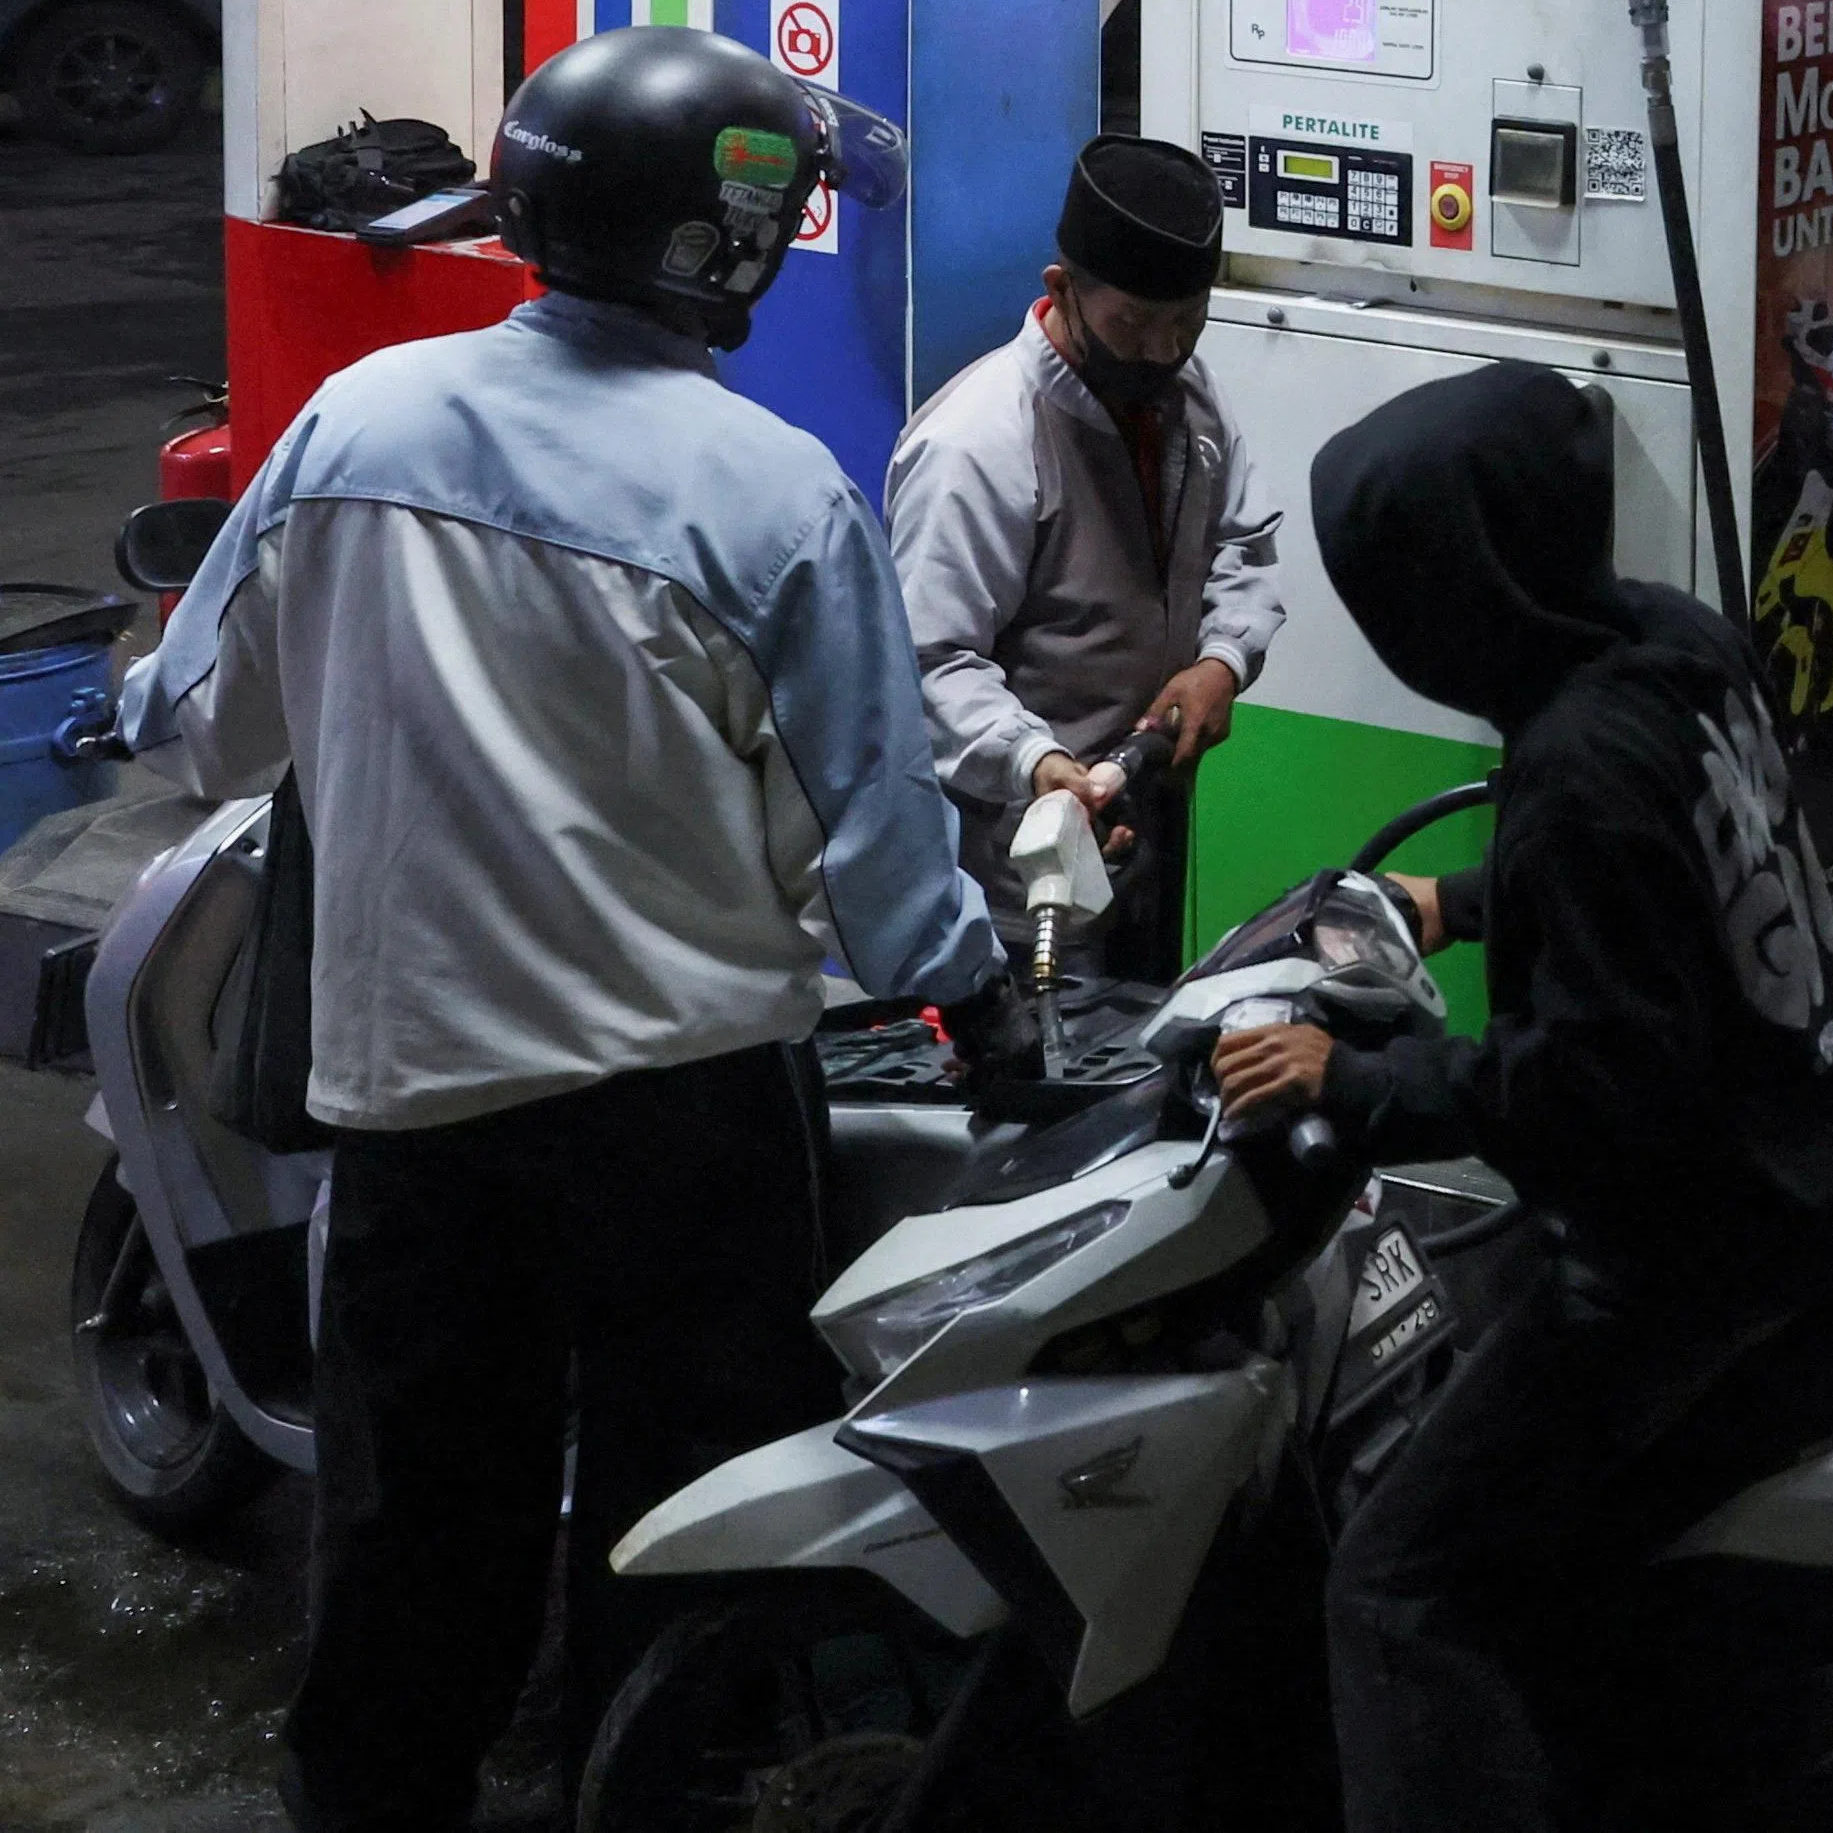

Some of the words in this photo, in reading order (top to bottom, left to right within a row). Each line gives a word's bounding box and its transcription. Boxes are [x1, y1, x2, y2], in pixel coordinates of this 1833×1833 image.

[1250, 23, 1266, 40] Rp
[502, 120, 583, 162] Cargloss
[1282, 114, 1380, 141] PERTALITE
